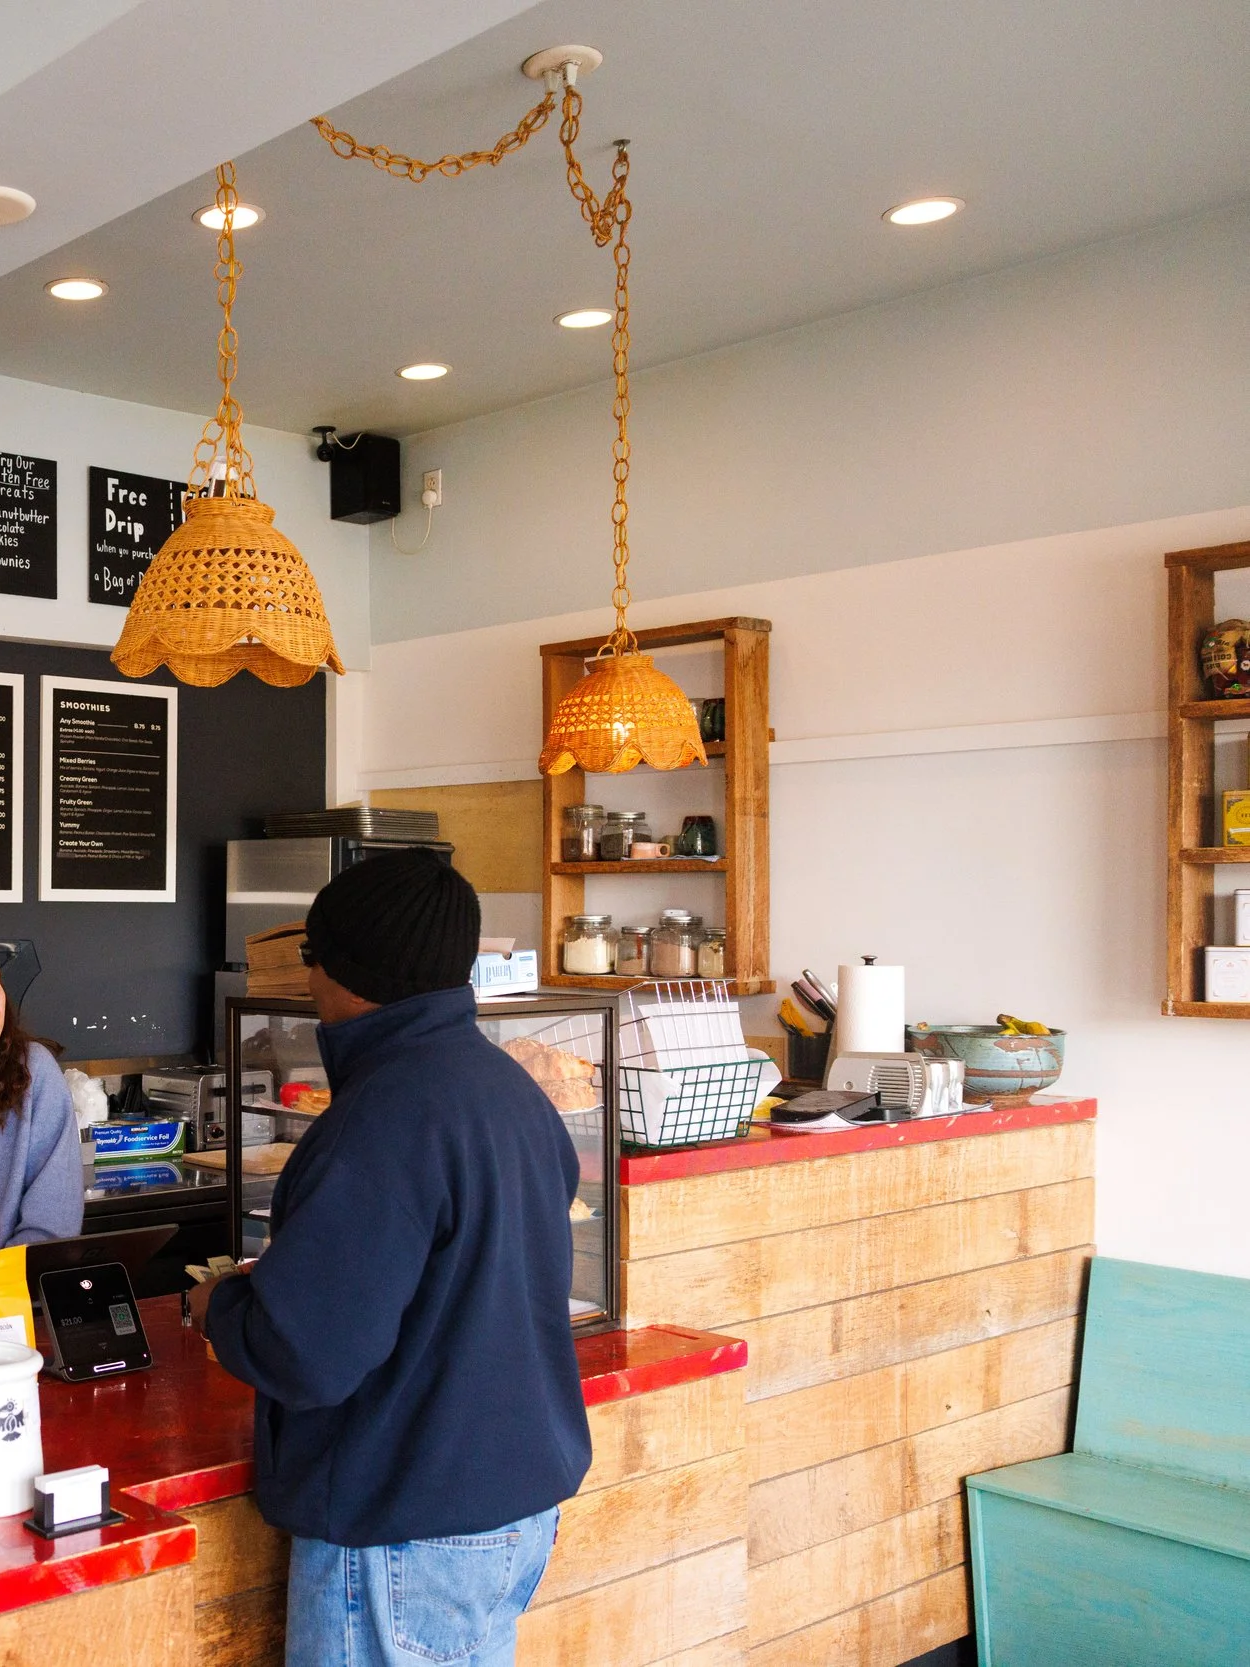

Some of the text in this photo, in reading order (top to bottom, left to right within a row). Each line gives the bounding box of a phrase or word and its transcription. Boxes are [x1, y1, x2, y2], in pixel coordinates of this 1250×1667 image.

[16, 455, 35, 470] Our
[26, 472, 50, 488] Free
[107, 477, 148, 507] Free
[105, 508, 145, 542] Drip
[96, 539, 129, 558] when you
[94, 573, 99, 581] a
[104, 566, 124, 594] Bag
[127, 576, 135, 586] of
[60, 701, 110, 712] SMOOTHIES
[60, 718, 71, 726] Any
